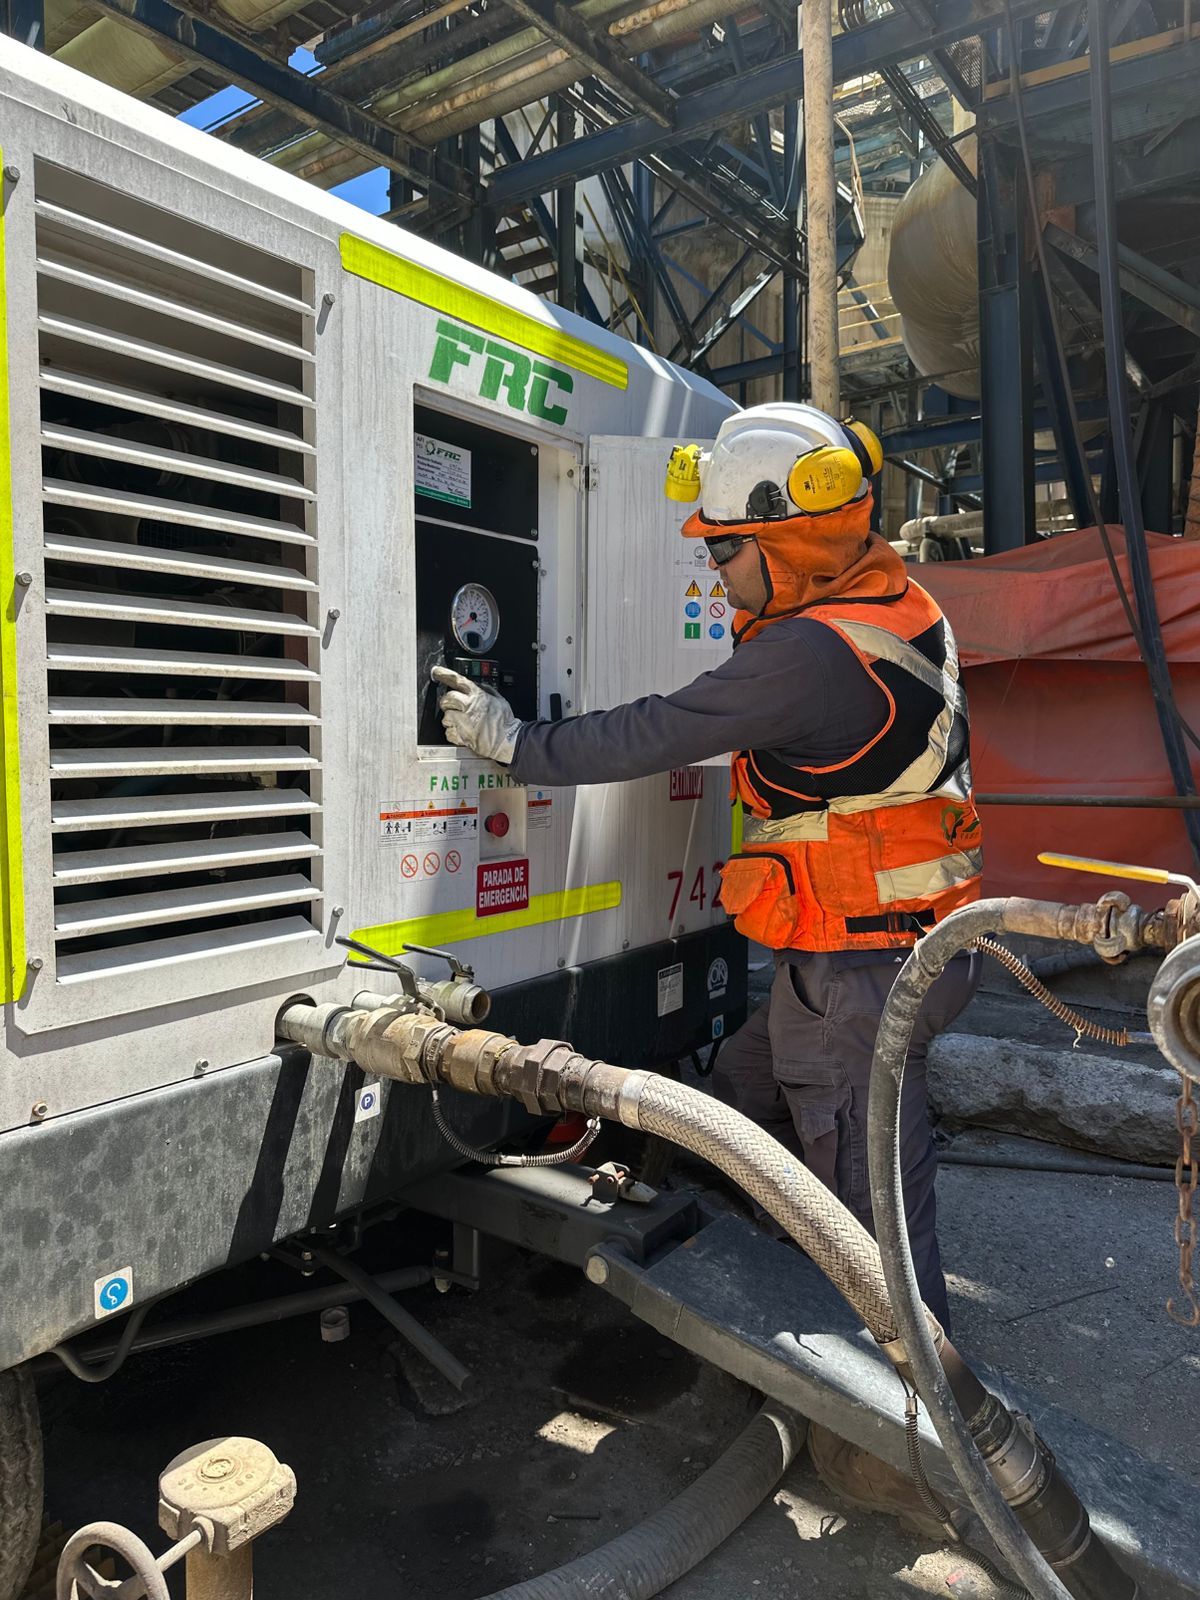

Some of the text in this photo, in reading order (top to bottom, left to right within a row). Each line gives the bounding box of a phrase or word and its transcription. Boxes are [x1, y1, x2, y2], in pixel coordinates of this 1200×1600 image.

[428, 318, 574, 426] FRC
[436, 448, 461, 461] FRC
[430, 773, 528, 791] FAST RENT
[483, 866, 524, 887] PARADA DE
[479, 885, 527, 908] EMERGENCIA
